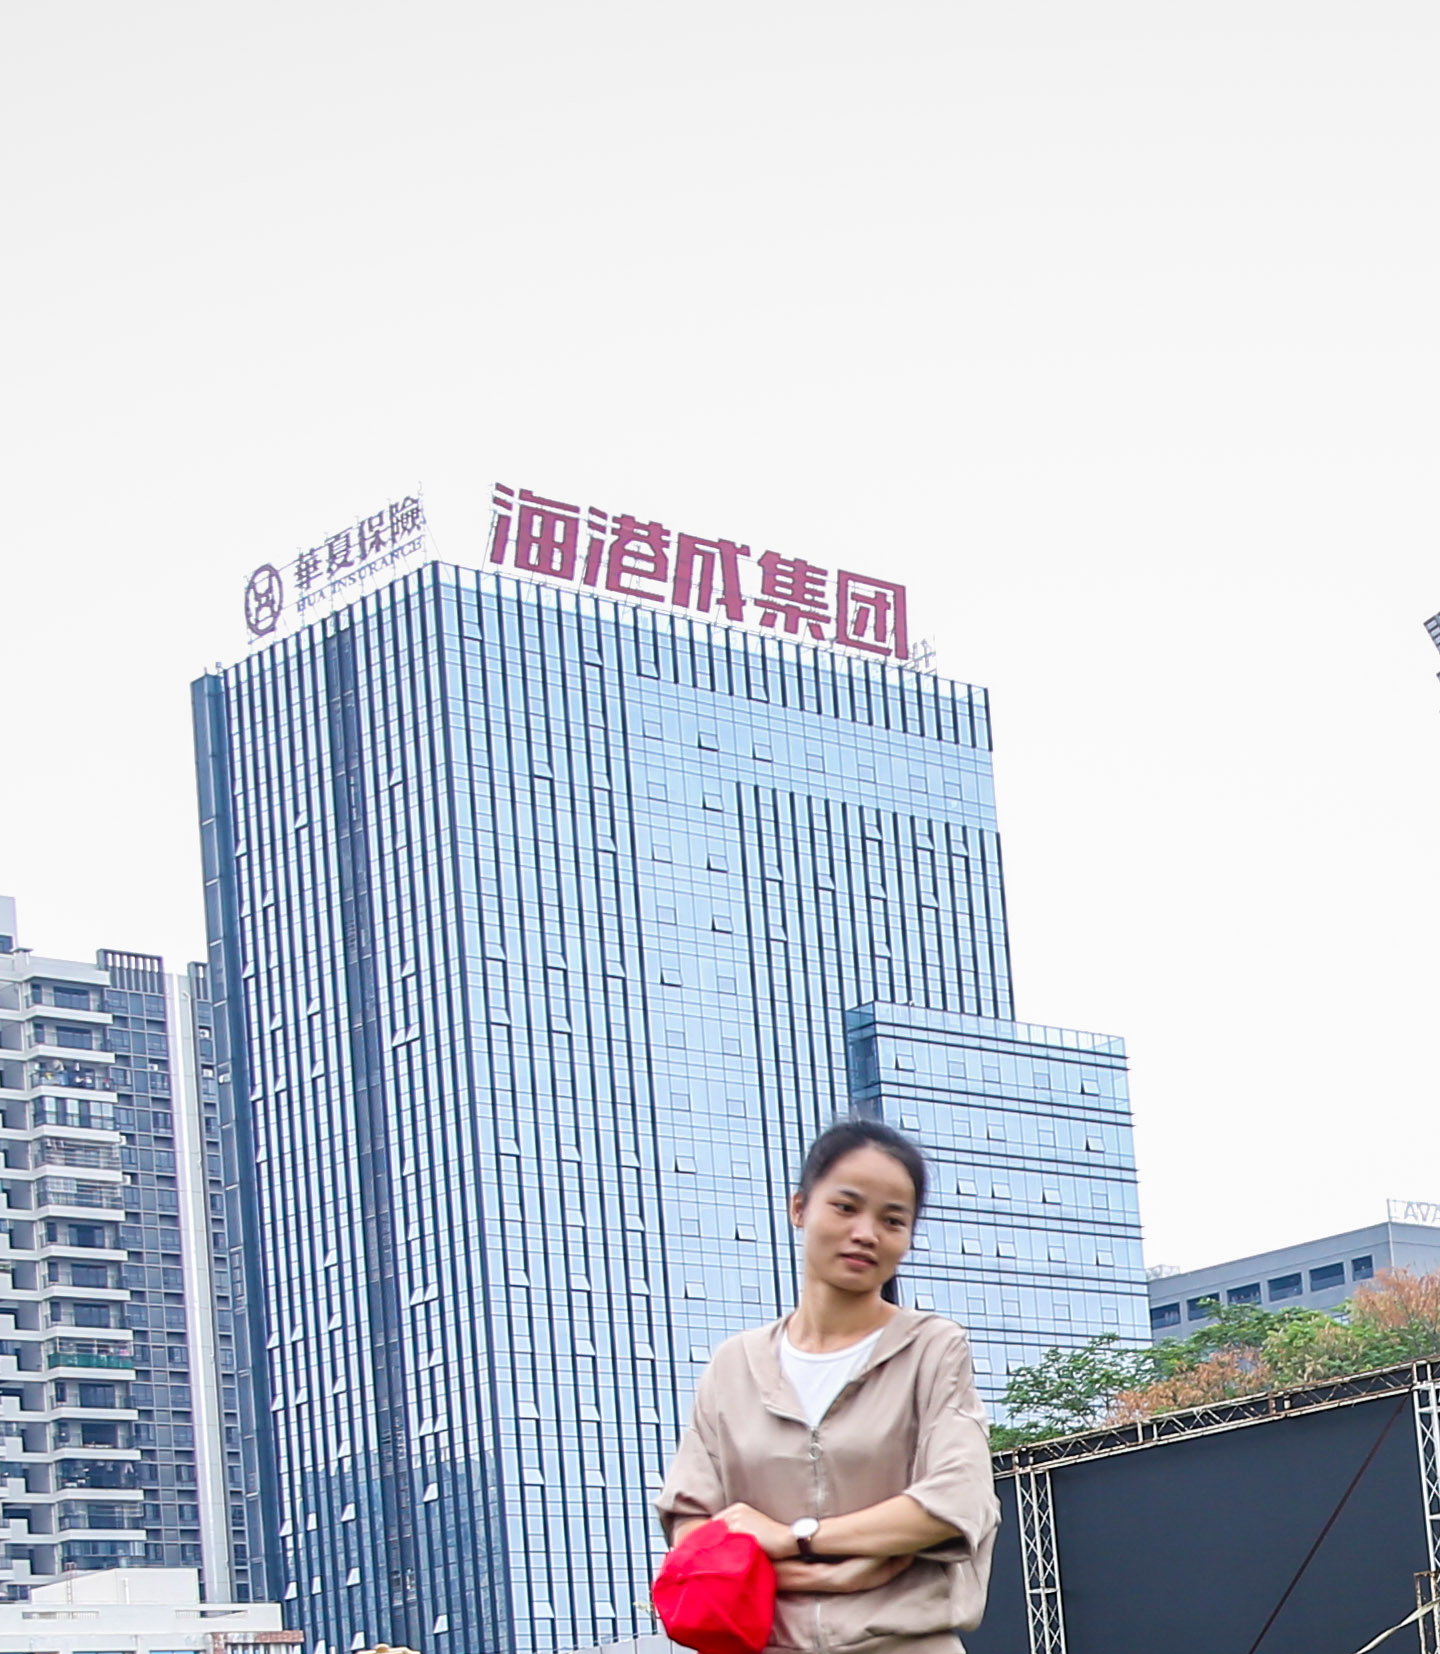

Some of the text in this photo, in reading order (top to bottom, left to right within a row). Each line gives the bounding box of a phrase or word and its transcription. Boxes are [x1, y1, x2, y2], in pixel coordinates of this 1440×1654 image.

[490, 482, 909, 660] 海港成集团
